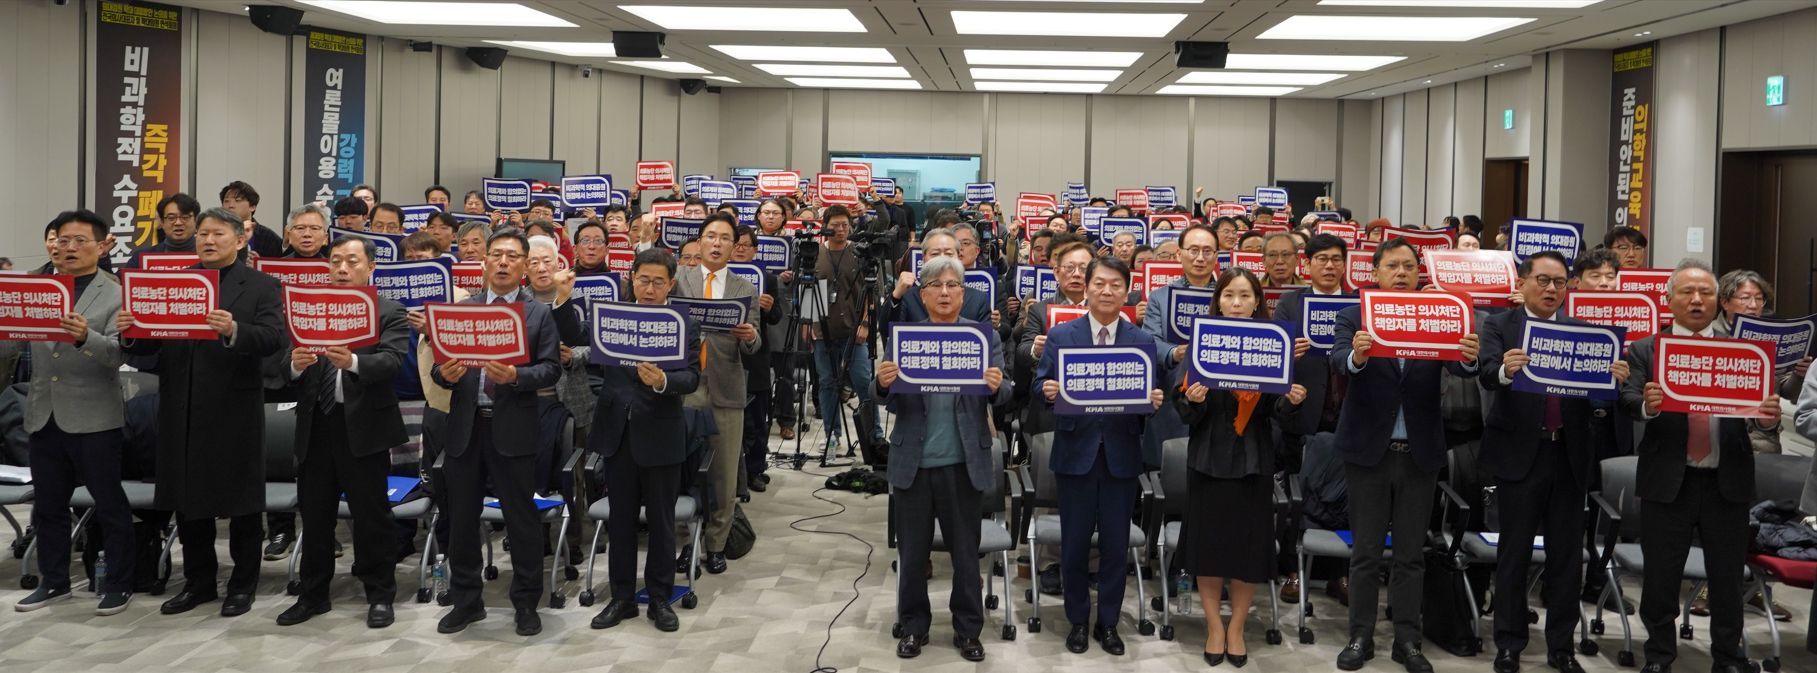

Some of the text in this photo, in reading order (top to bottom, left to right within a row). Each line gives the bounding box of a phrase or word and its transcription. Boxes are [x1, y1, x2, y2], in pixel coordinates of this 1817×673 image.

[317, 67, 344, 179] 여론몰이용
[1617, 87, 1637, 201] 준비안된
[109, 45, 149, 268] 비과학적 수요조
[339, 133, 357, 183] 강력
[1629, 103, 1649, 220] 의학교육
[135, 123, 169, 247] 즉각 폐기
[1518, 231, 1576, 247] 비과학적 의대증원
[376, 247, 392, 257] 증원
[1352, 261, 1373, 271] 의료농
[1436, 261, 1505, 273] 의료농단 의사처단
[299, 272, 332, 284] 의사처단
[375, 273, 443, 288] 의료계와 합의없는
[461, 276, 483, 286] 의사처
[1022, 276, 1035, 286] 의료
[1438, 272, 1508, 285] 책임자를 처벌하라
[23, 293, 62, 306] 의사처단
[131, 286, 206, 301] 의료농단 의사처단
[377, 285, 445, 301] 의료정책 철회하라
[25, 306, 62, 320] 처벌하라
[132, 301, 206, 316] 책임자를 처벌하라
[291, 302, 366, 316] 의료농단 의사처단
[689, 307, 740, 317] 계와 합의없는
[1310, 310, 1337, 322] 비과학
[1373, 304, 1461, 318] 의료농단 의사처단
[1576, 305, 1650, 319] 의료농단 의사처단
[292, 315, 367, 331] 책임자를 처벌하라
[437, 318, 514, 332] 의료농단 의사처단
[601, 316, 677, 334] 비과학적 의대증원
[1177, 316, 1191, 327] 의료
[1374, 317, 1462, 334] 책임자를 처벌하라
[1310, 324, 1335, 336] 원점에
[1741, 329, 1810, 344] 비과학적 의대증원
[439, 332, 516, 347] 책임자를 처벌하라
[601, 331, 677, 348] 원점에서 논의하라
[1201, 334, 1283, 353] 의료계와 합의없는
[1531, 336, 1613, 358] 비과학적 의대증원
[901, 340, 980, 355] 의료계와 합의없는
[1778, 342, 1807, 356] 논의하라
[619, 359, 637, 367] KMA
[901, 356, 981, 370] 의료정책 철회하라
[1200, 350, 1282, 369] 의료정책 철회하라
[1529, 353, 1611, 374] 원점에서 논의하라
[1668, 353, 1761, 374] 의료농단 의사처단
[1066, 361, 1144, 376] 의료계와 합의없는
[1066, 377, 1145, 391] 의료정책 철회하라
[1218, 381, 1238, 389] KMA
[1667, 370, 1761, 391] 책임자를 처벌하라
[1546, 386, 1566, 395] KMA
[1689, 404, 1711, 412] KMA
